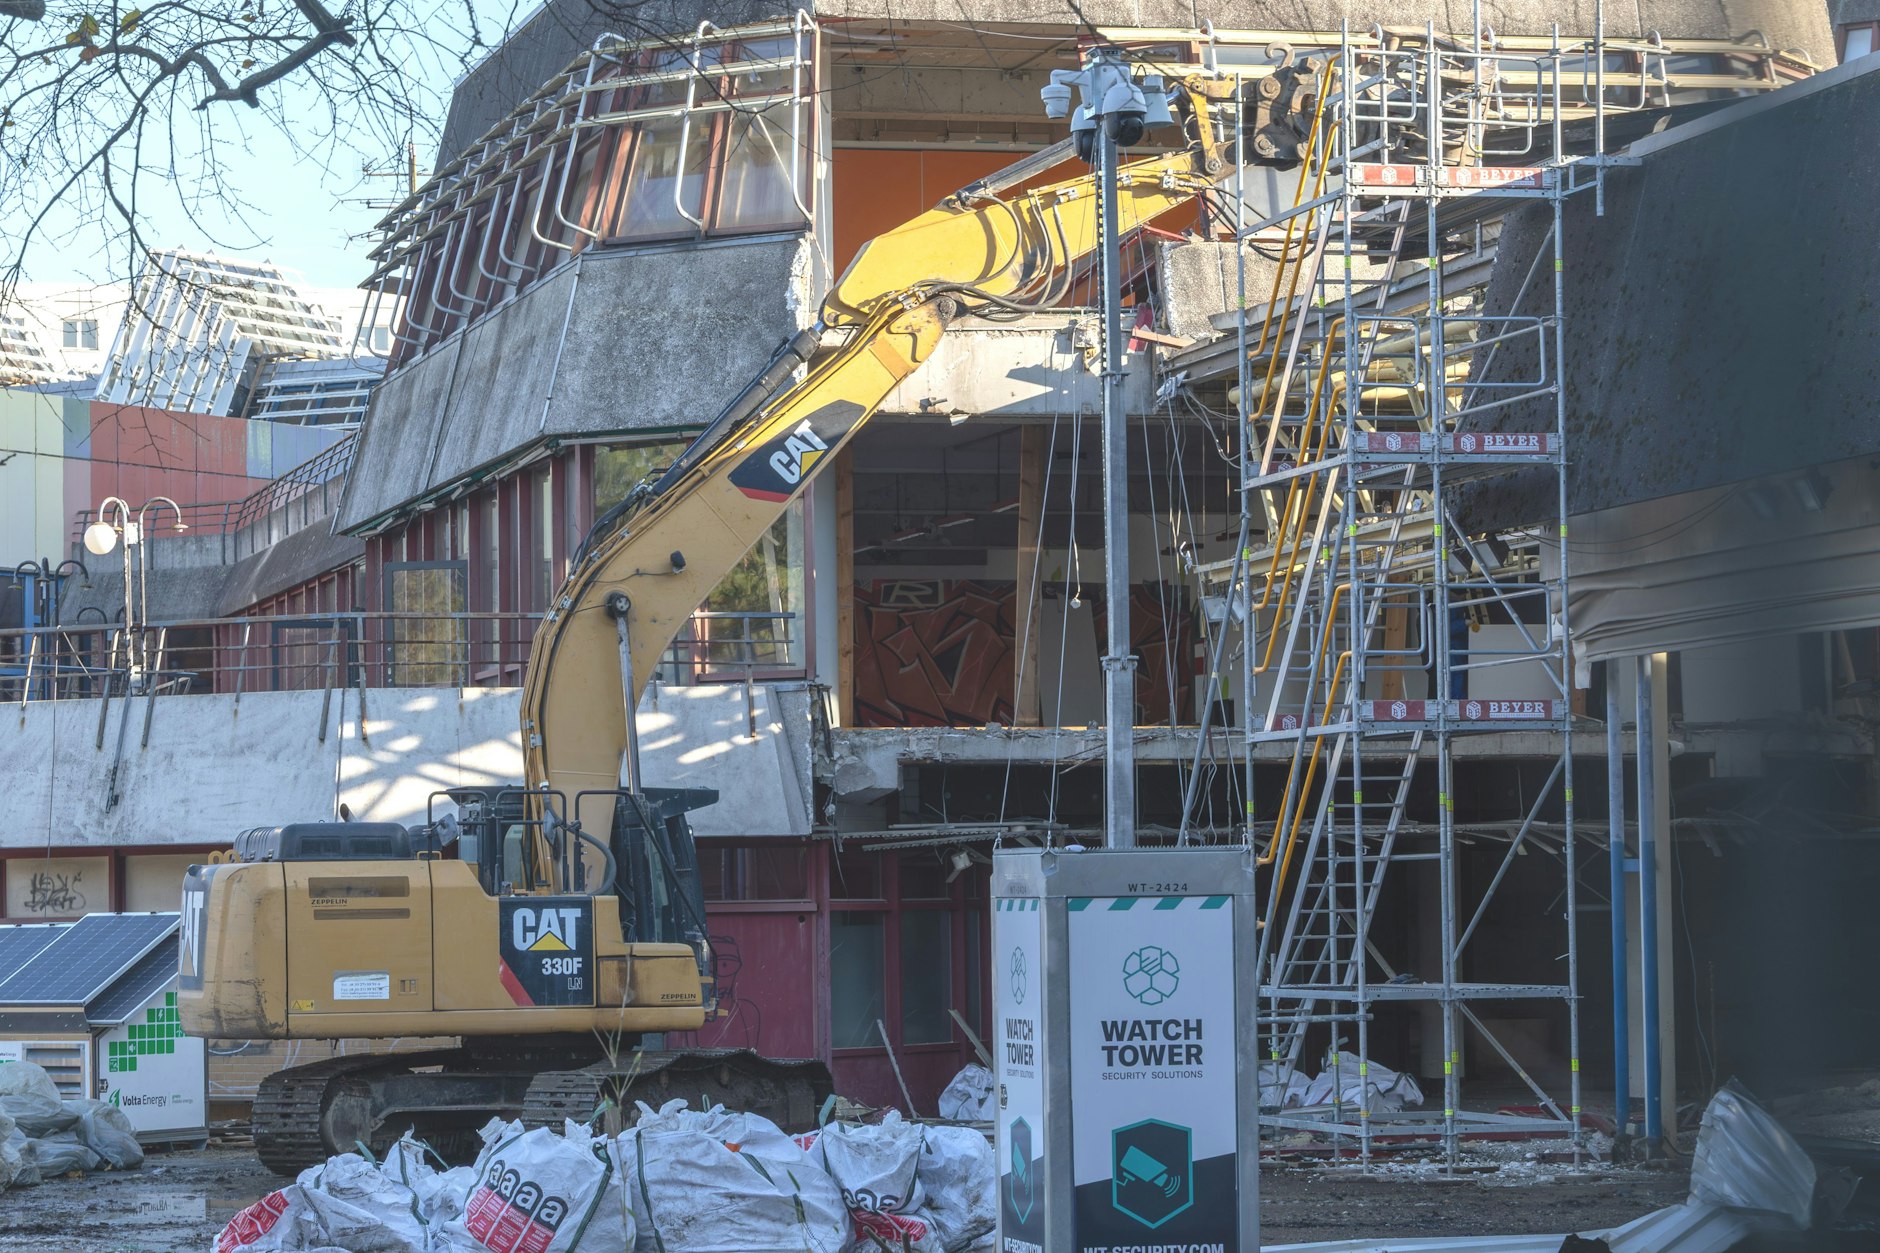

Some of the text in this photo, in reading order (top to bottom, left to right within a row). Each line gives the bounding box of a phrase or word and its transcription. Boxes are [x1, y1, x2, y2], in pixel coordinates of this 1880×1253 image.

[1480, 169, 1535, 181] BEYER
[1484, 435, 1539, 446] BEYER
[769, 419, 828, 484] CAT
[1489, 702, 1545, 713] BEYER
[1128, 883, 1188, 892] WT-2424
[513, 908, 582, 951] CAT
[541, 957, 583, 975] 330F
[568, 977, 583, 990] LN
[1006, 1018, 1033, 1041] WATCH
[1101, 1018, 1204, 1042] WATCH
[1006, 1043, 1034, 1067] TOWER
[1101, 1043, 1204, 1067] TOWER
[1102, 1070, 1204, 1080] SECURITY SOLUTIONS
[122, 1094, 167, 1107] Volta Energy
